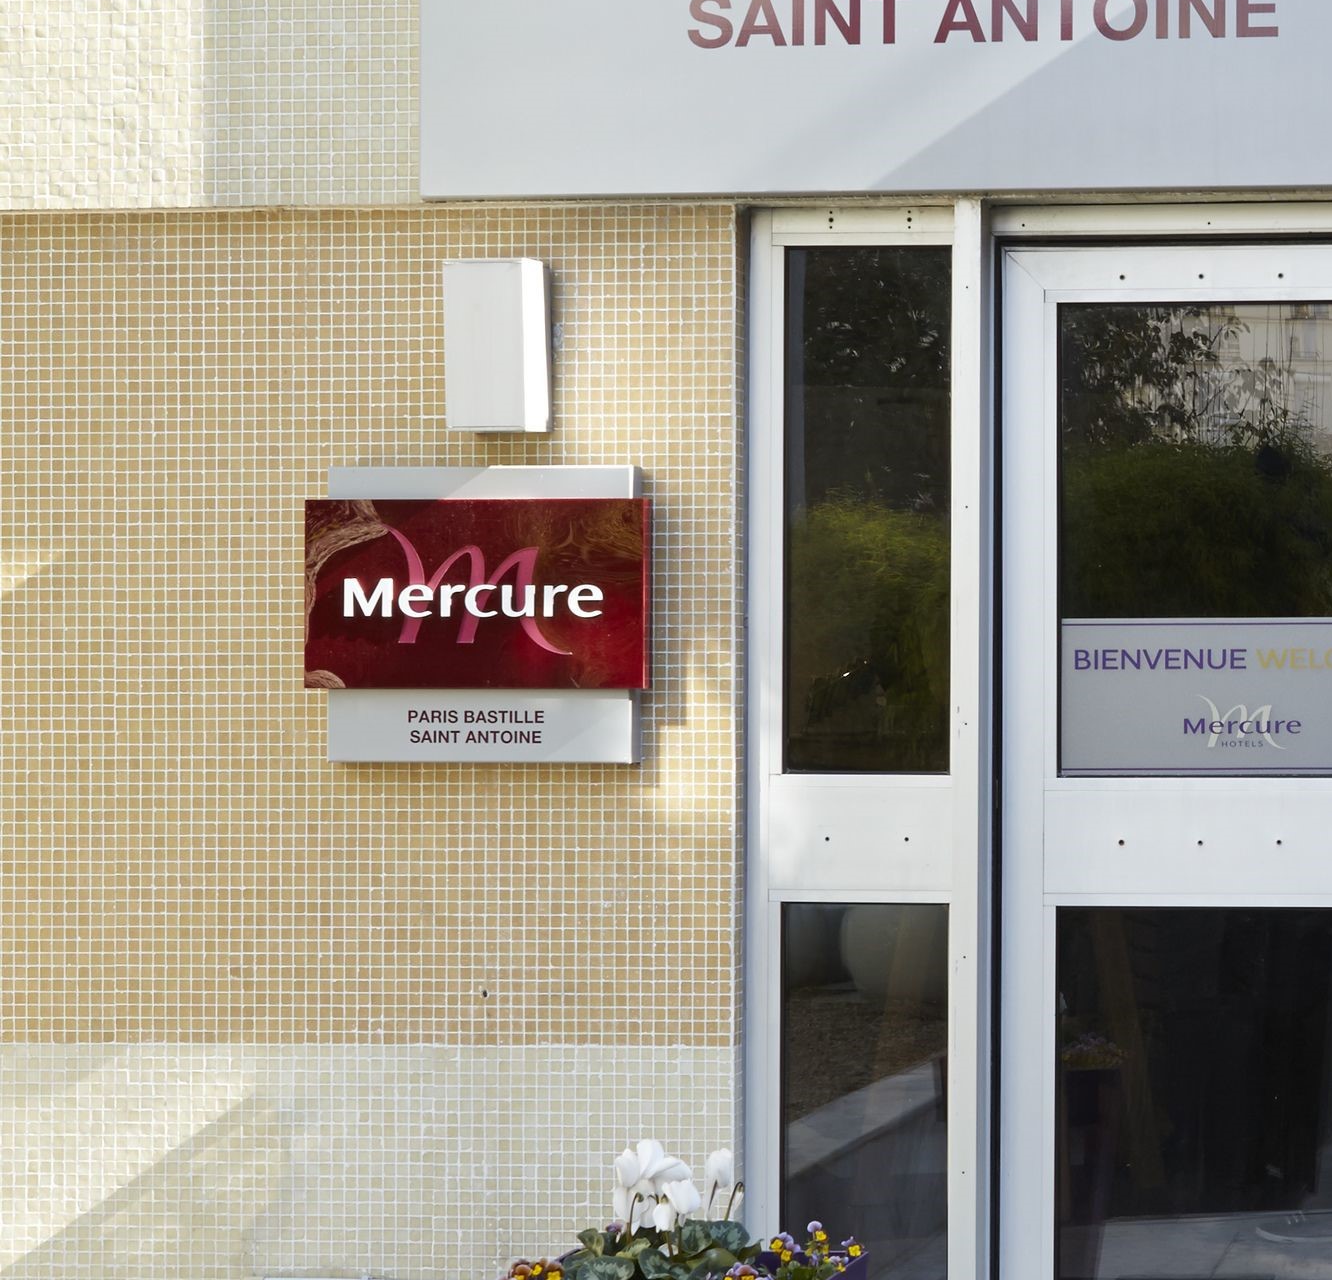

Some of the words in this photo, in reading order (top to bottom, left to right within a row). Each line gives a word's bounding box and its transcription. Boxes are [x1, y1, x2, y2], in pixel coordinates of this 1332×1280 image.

[342, 577, 604, 618] Mercure
[1074, 648, 1247, 671] BIENVENUE
[407, 710, 458, 724] PARIS
[463, 710, 545, 724] BASTILLE
[1183, 718, 1302, 735] Mercure
[409, 730, 460, 744] SAINT
[465, 730, 542, 744] ANTOINE
[1221, 740, 1264, 748] HOTELS
